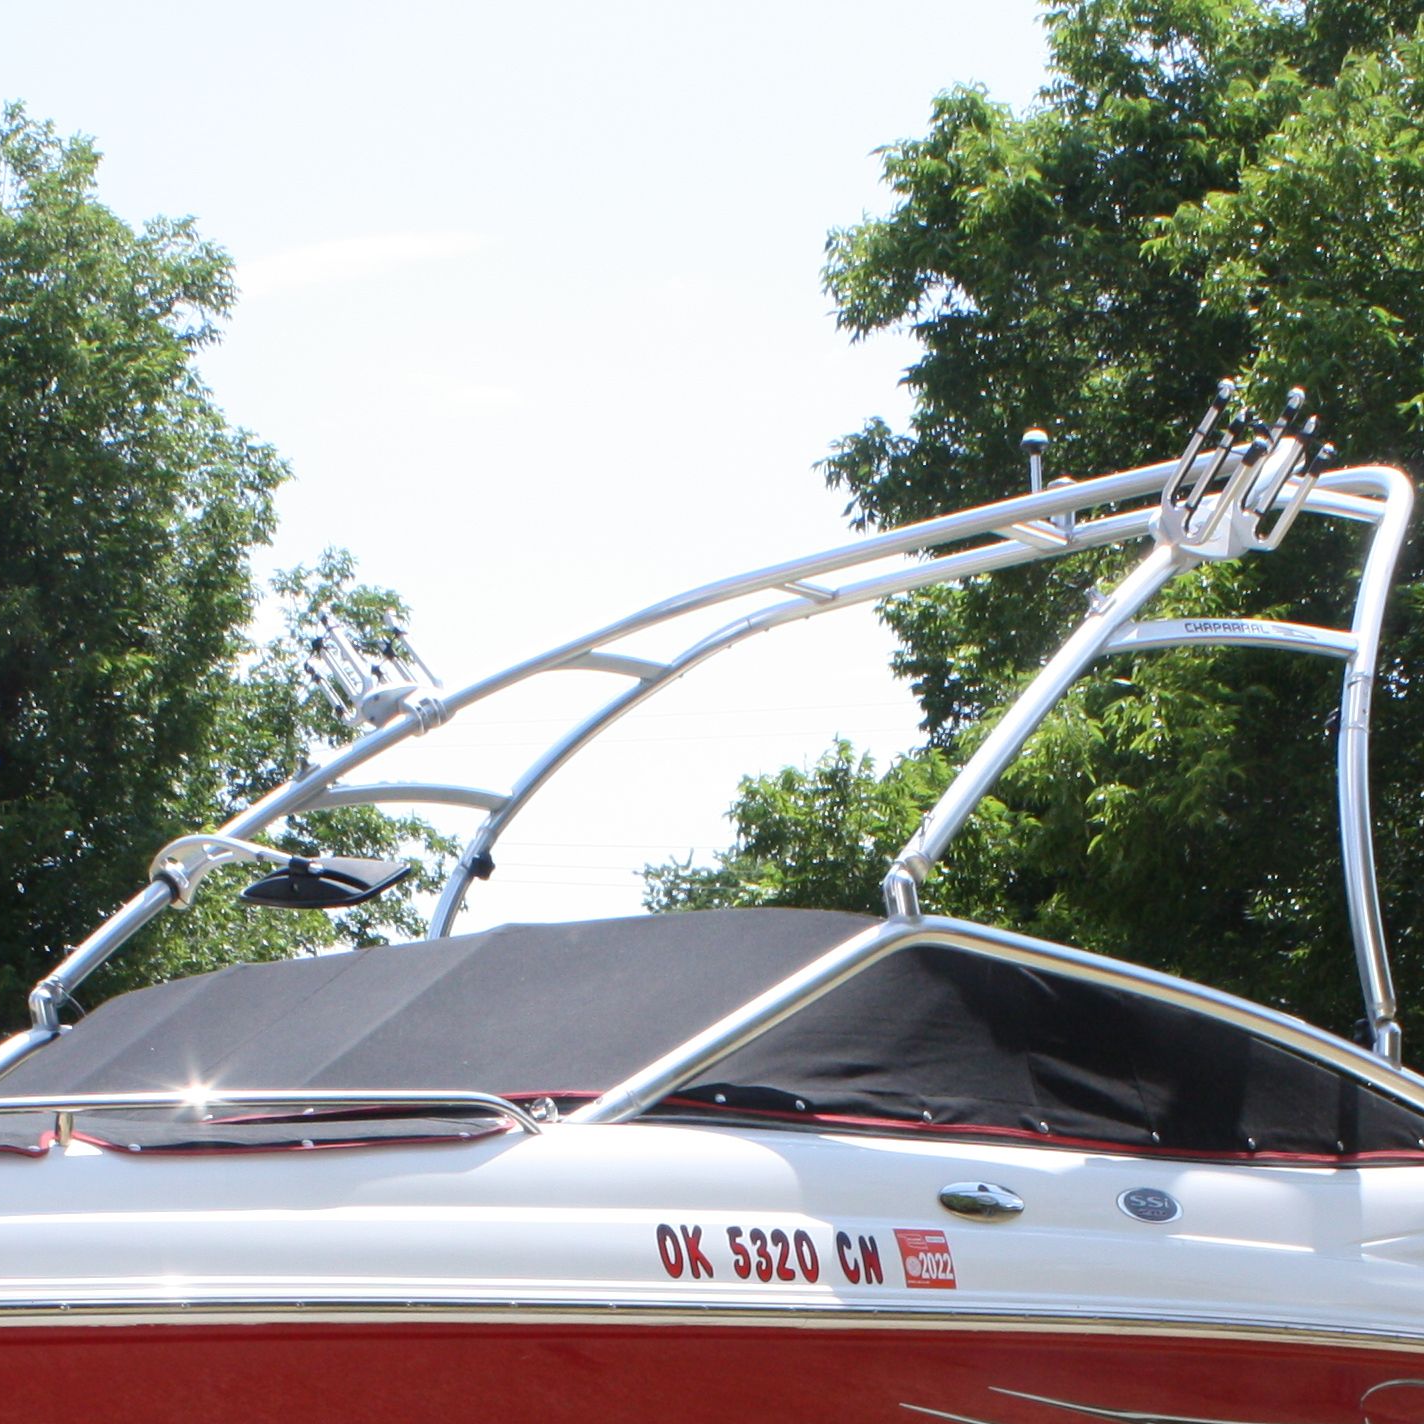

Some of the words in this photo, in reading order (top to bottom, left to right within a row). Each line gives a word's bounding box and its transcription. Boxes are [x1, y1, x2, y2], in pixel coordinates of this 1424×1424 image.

[1184, 622, 1270, 634] CHAPARRAL
[1129, 1195, 1170, 1208] SSi
[656, 1223, 714, 1279] OK
[726, 1226, 820, 1283] 5320
[836, 1230, 884, 1285] CN
[918, 1251, 954, 1279] 2022
